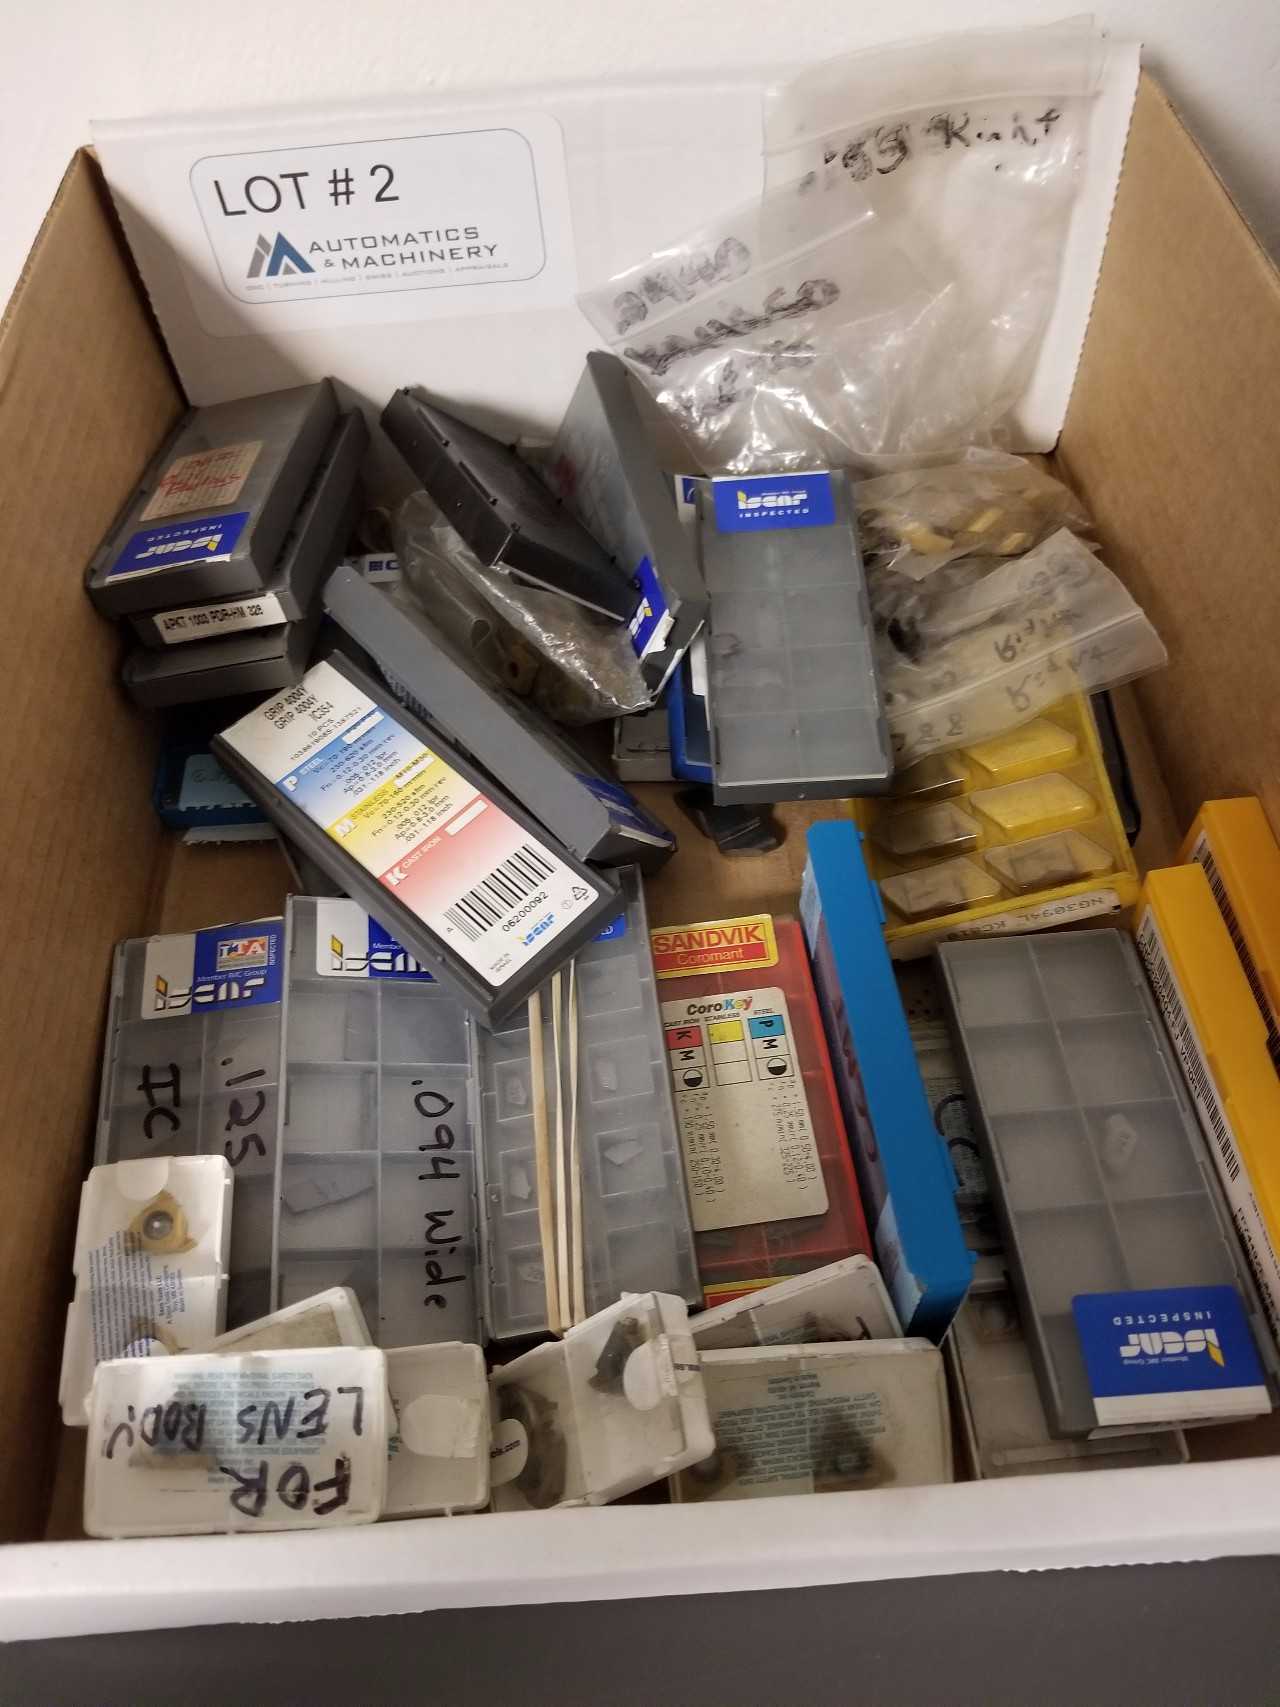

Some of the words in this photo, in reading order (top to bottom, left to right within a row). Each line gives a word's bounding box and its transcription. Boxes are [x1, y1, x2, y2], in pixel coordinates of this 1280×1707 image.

[213, 171, 310, 217] LOT
[327, 168, 355, 206] #
[369, 164, 400, 202] 2
[309, 226, 480, 254] AUTOMATICS
[324, 259, 335, 268] &
[341, 243, 498, 269] MACHINERY
[739, 508, 809, 519] INSPECTED
[264, 701, 286, 721] GRIP
[274, 711, 295, 729] GRIP
[309, 700, 333, 721] IC354
[282, 774, 301, 792] P
[385, 865, 409, 887] K
[500, 890, 549, 933] 06200092
[653, 925, 764, 953] SANDVIK
[678, 948, 745, 965] Coromant
[687, 996, 753, 1016] CoroKey
[759, 1020, 774, 1028] P
[676, 1031, 693, 1040] K
[763, 1038, 780, 1049] M
[680, 1050, 696, 1061] M
[137, 1063, 181, 1139] IC
[1113, 1311, 1211, 1326] INSPECTED
[238, 1386, 363, 1446] LENS
[220, 1455, 352, 1516] FOR
